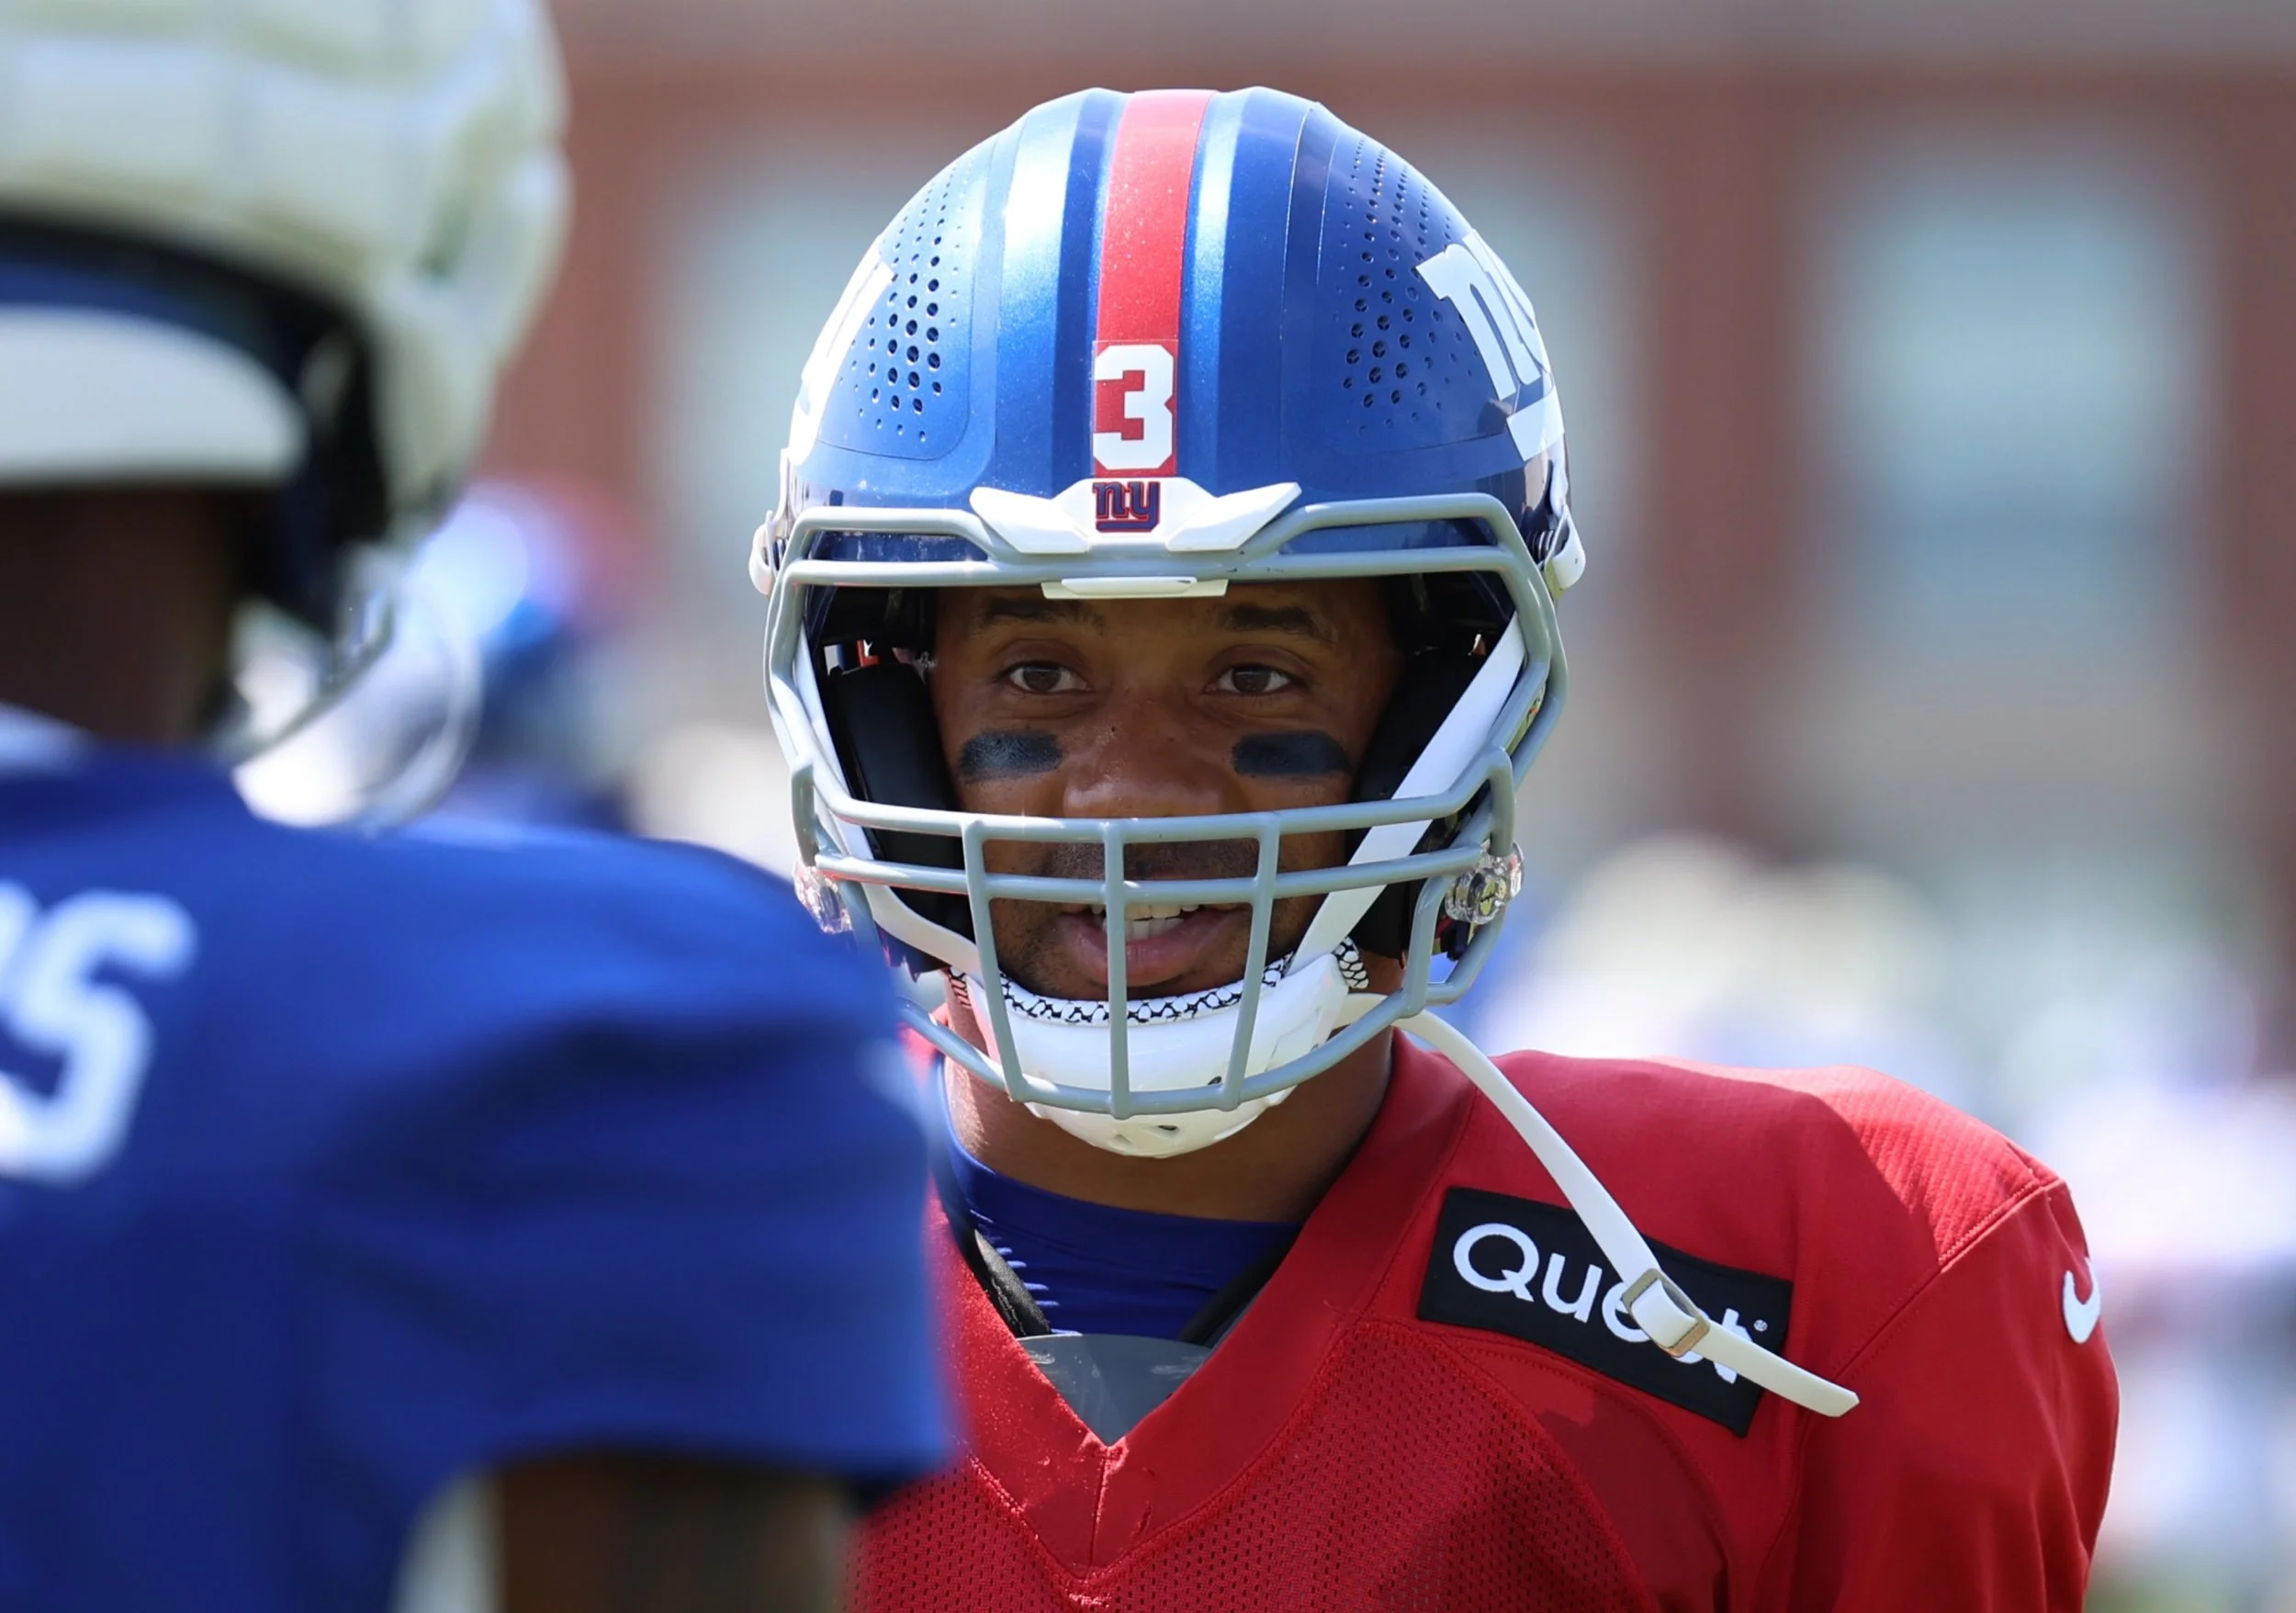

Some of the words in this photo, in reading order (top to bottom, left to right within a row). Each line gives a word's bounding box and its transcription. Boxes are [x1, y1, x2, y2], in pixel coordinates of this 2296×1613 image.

[1093, 344, 1174, 470] 3
[0, 879, 197, 1187] S
[1453, 1223, 1754, 1384] Quet
